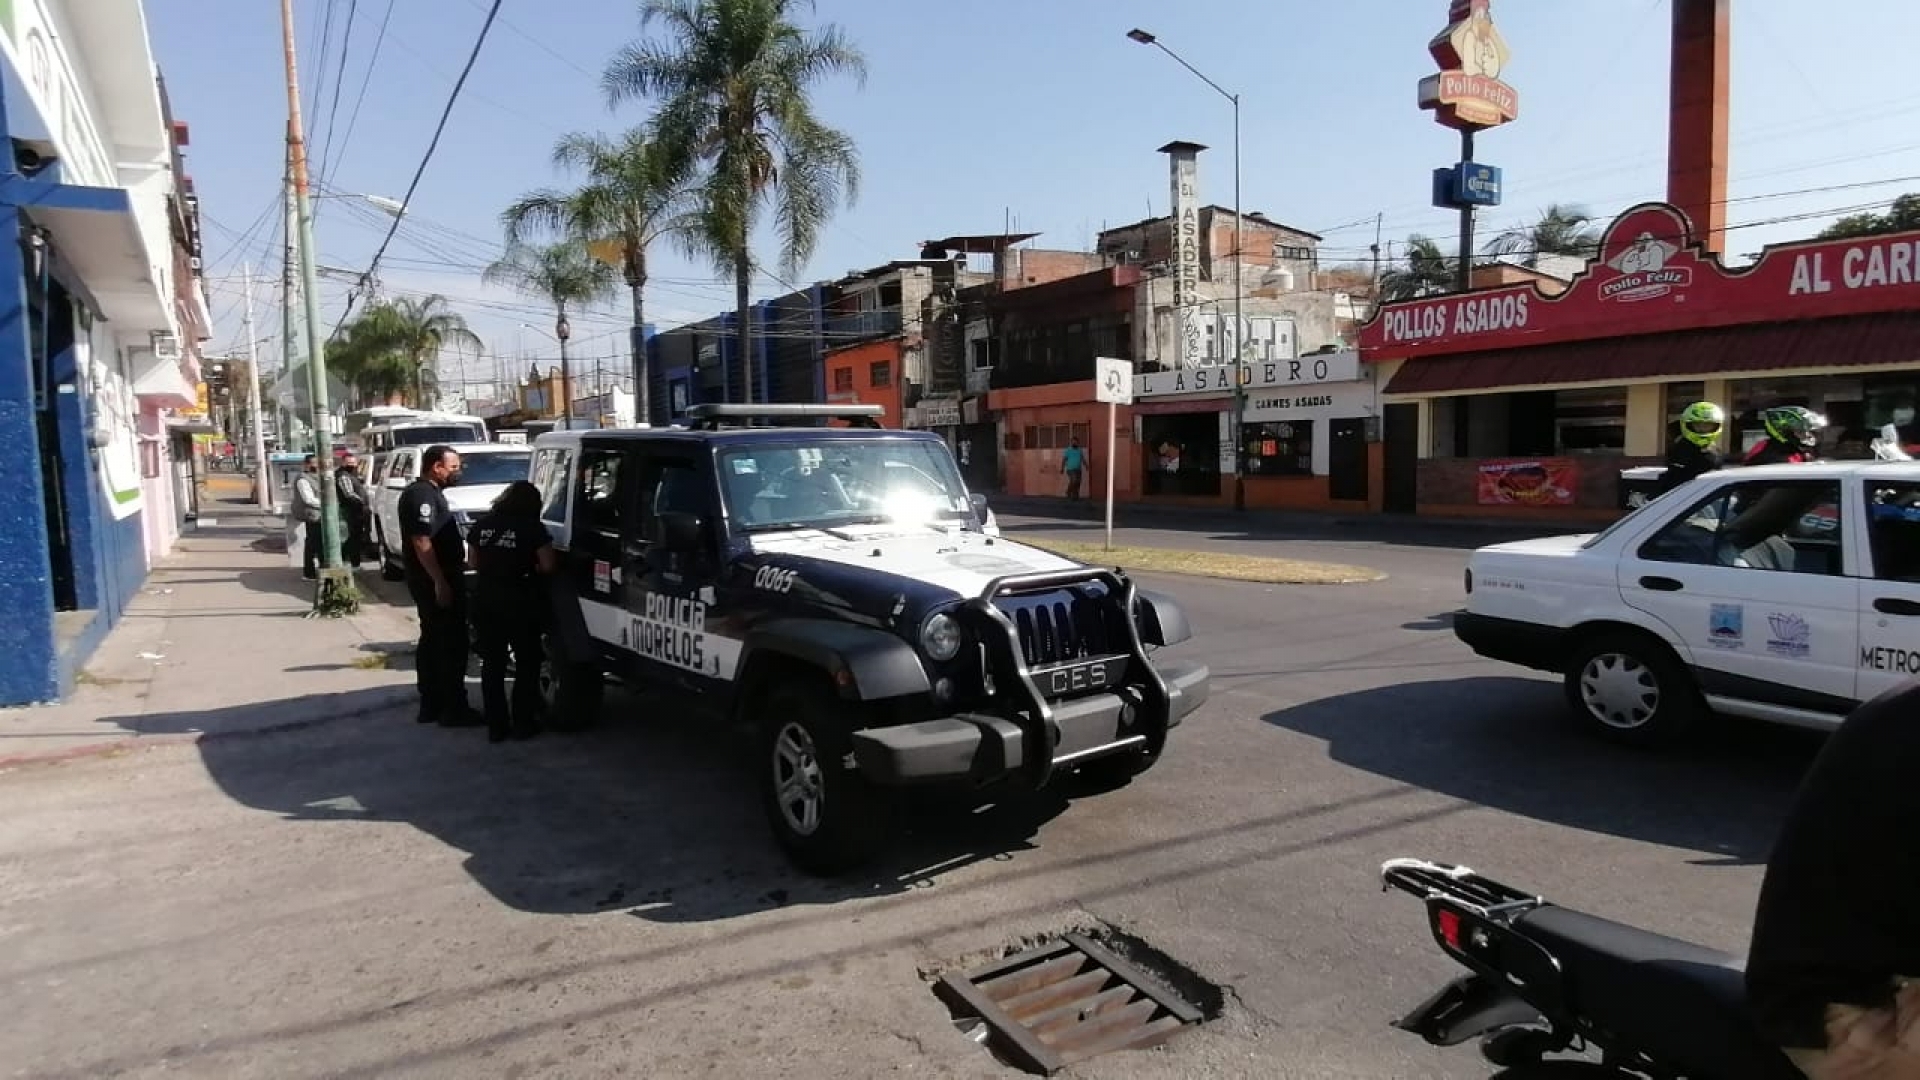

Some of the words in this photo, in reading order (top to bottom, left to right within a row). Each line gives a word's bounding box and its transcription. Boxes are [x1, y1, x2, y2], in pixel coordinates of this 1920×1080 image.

[1446, 76, 1480, 95] Pollo
[1484, 82, 1512, 109] Feliz
[1603, 276, 1642, 295] Pollo
[1646, 271, 1683, 283] Feliz
[1788, 251, 1832, 296] AL
[1842, 240, 1920, 289] CAR
[1383, 304, 1447, 341] POLLOS
[1454, 293, 1528, 334] ASADOS
[1175, 360, 1329, 391] ASADERO
[1295, 396, 1333, 408] ASADAS
[754, 564, 798, 593] 0065
[631, 617, 704, 670] MORELOS
[1052, 663, 1107, 693] CES
